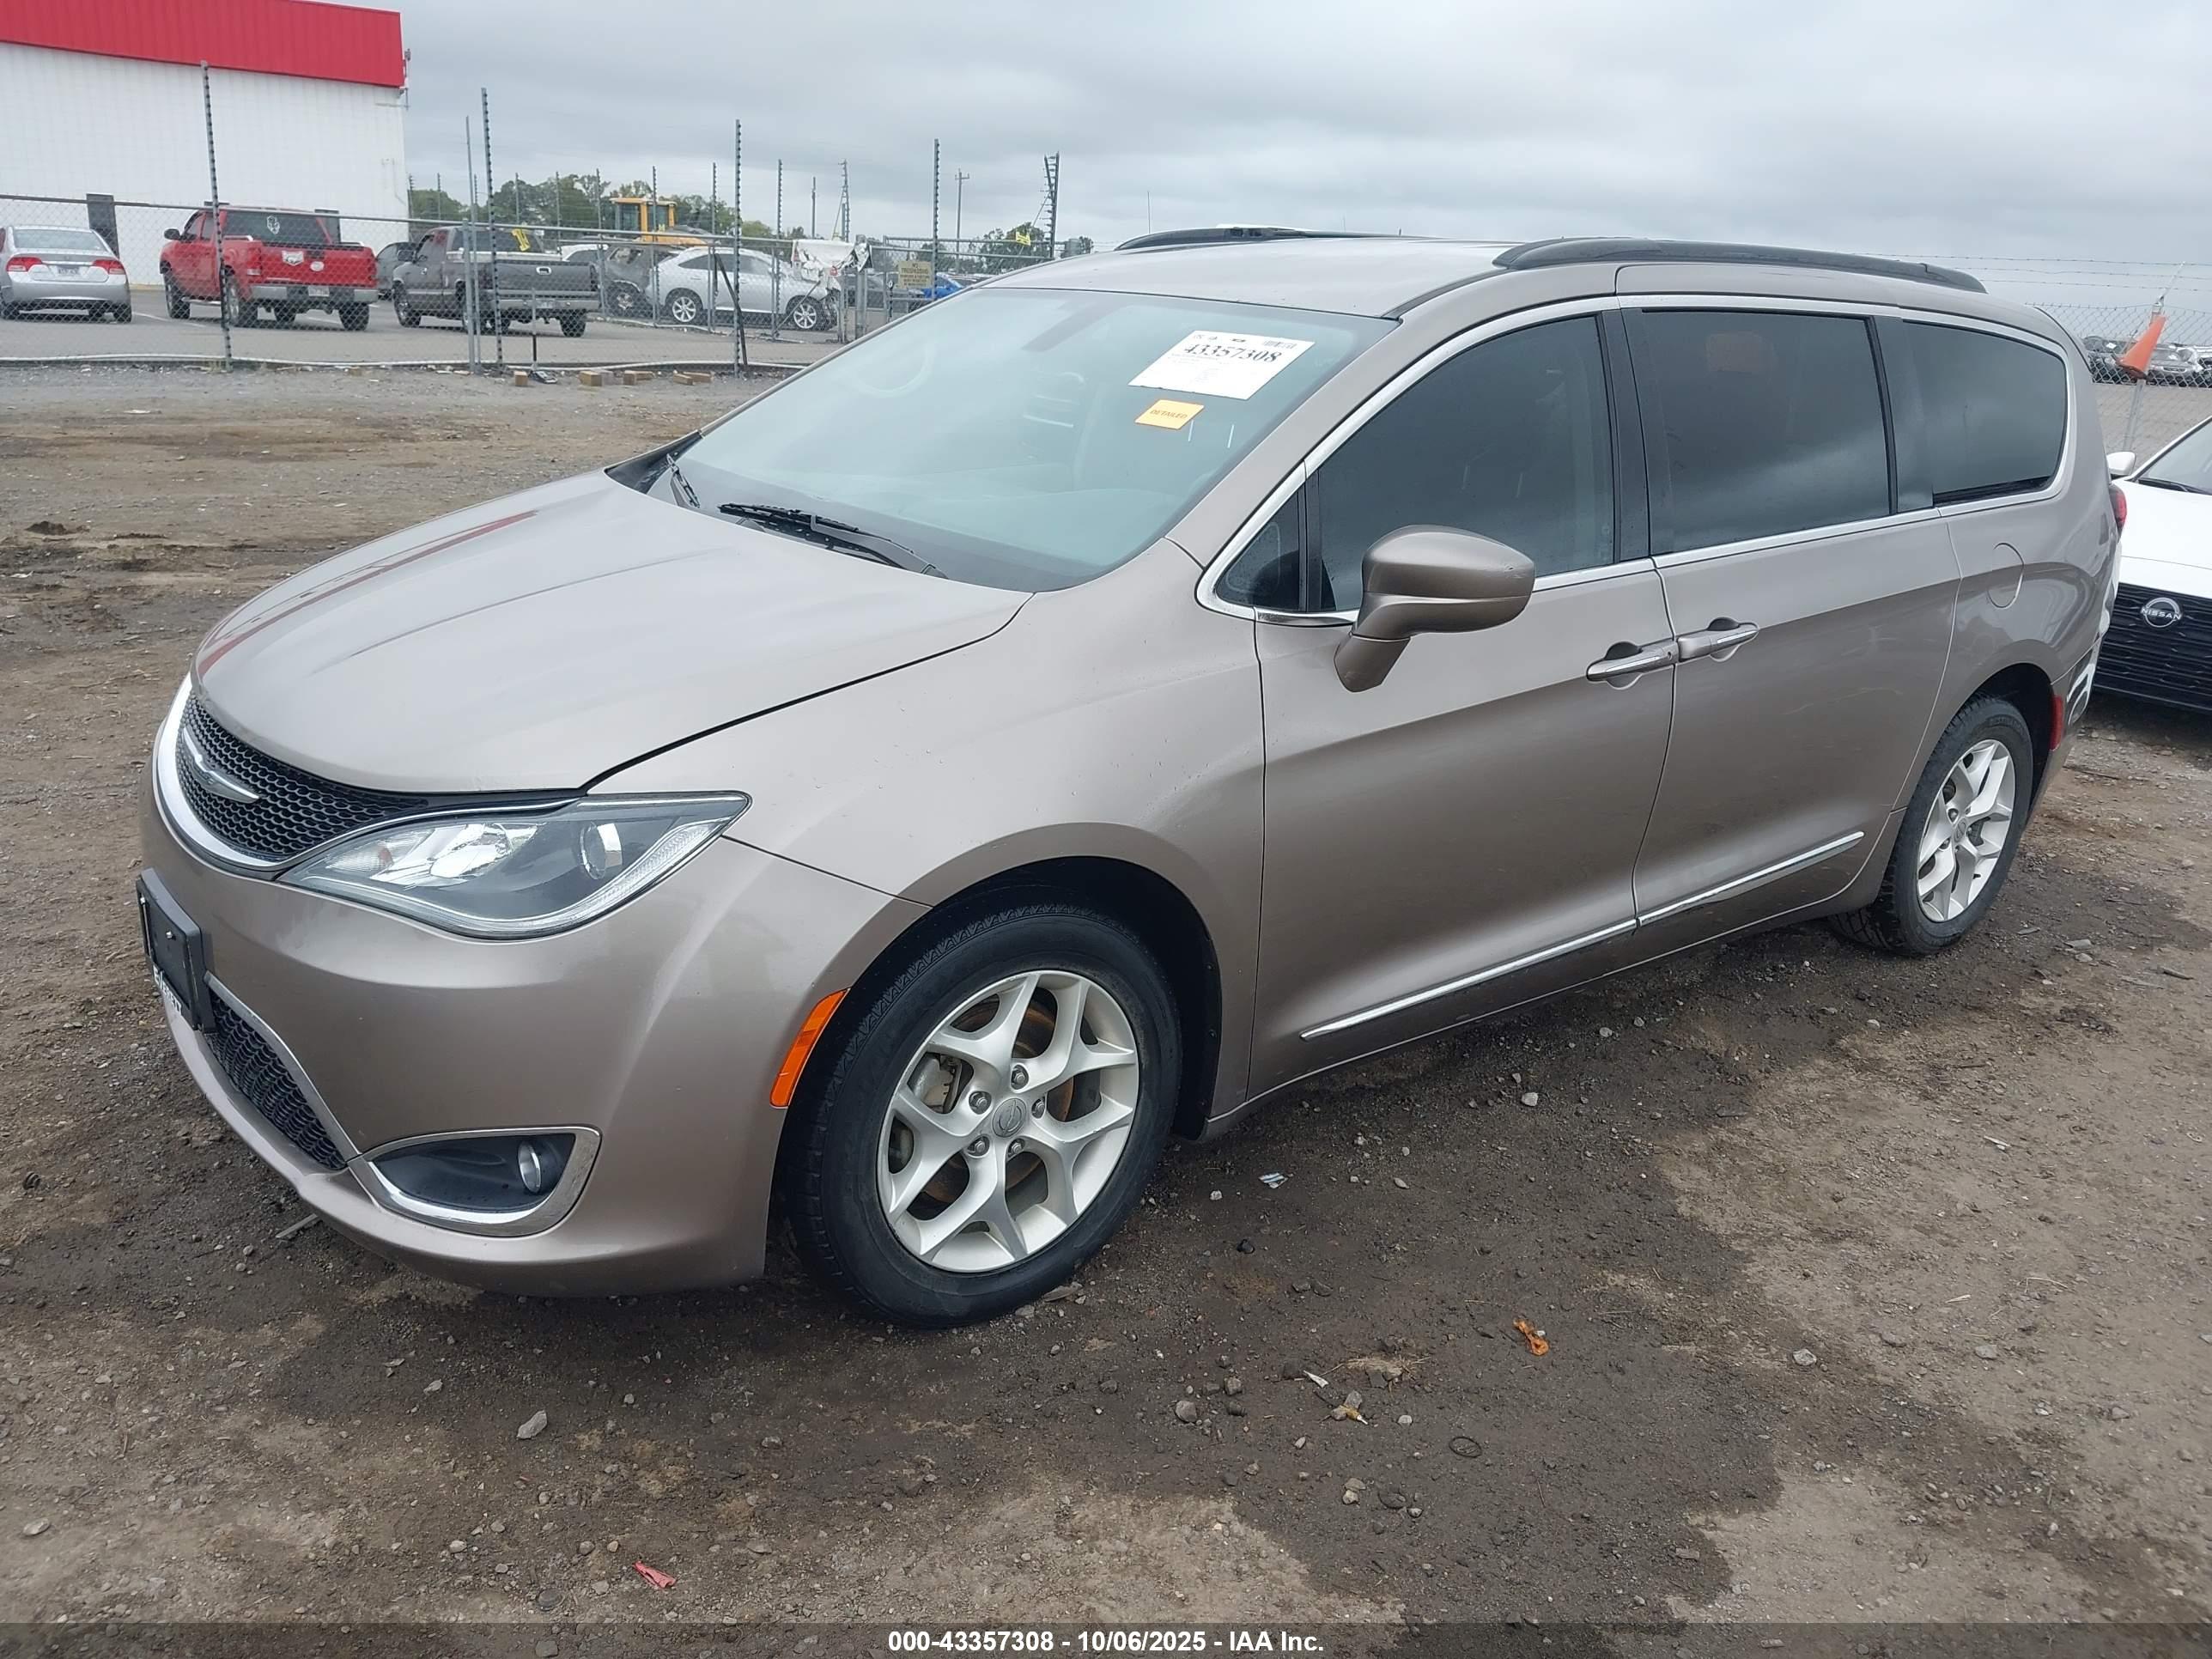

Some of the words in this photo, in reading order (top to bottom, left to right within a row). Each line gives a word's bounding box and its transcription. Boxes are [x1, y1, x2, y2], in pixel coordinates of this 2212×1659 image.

[1184, 343, 1282, 363] 43357308
[1149, 409, 1188, 420] DETAILED
[2140, 607, 2182, 621] NISSAN
